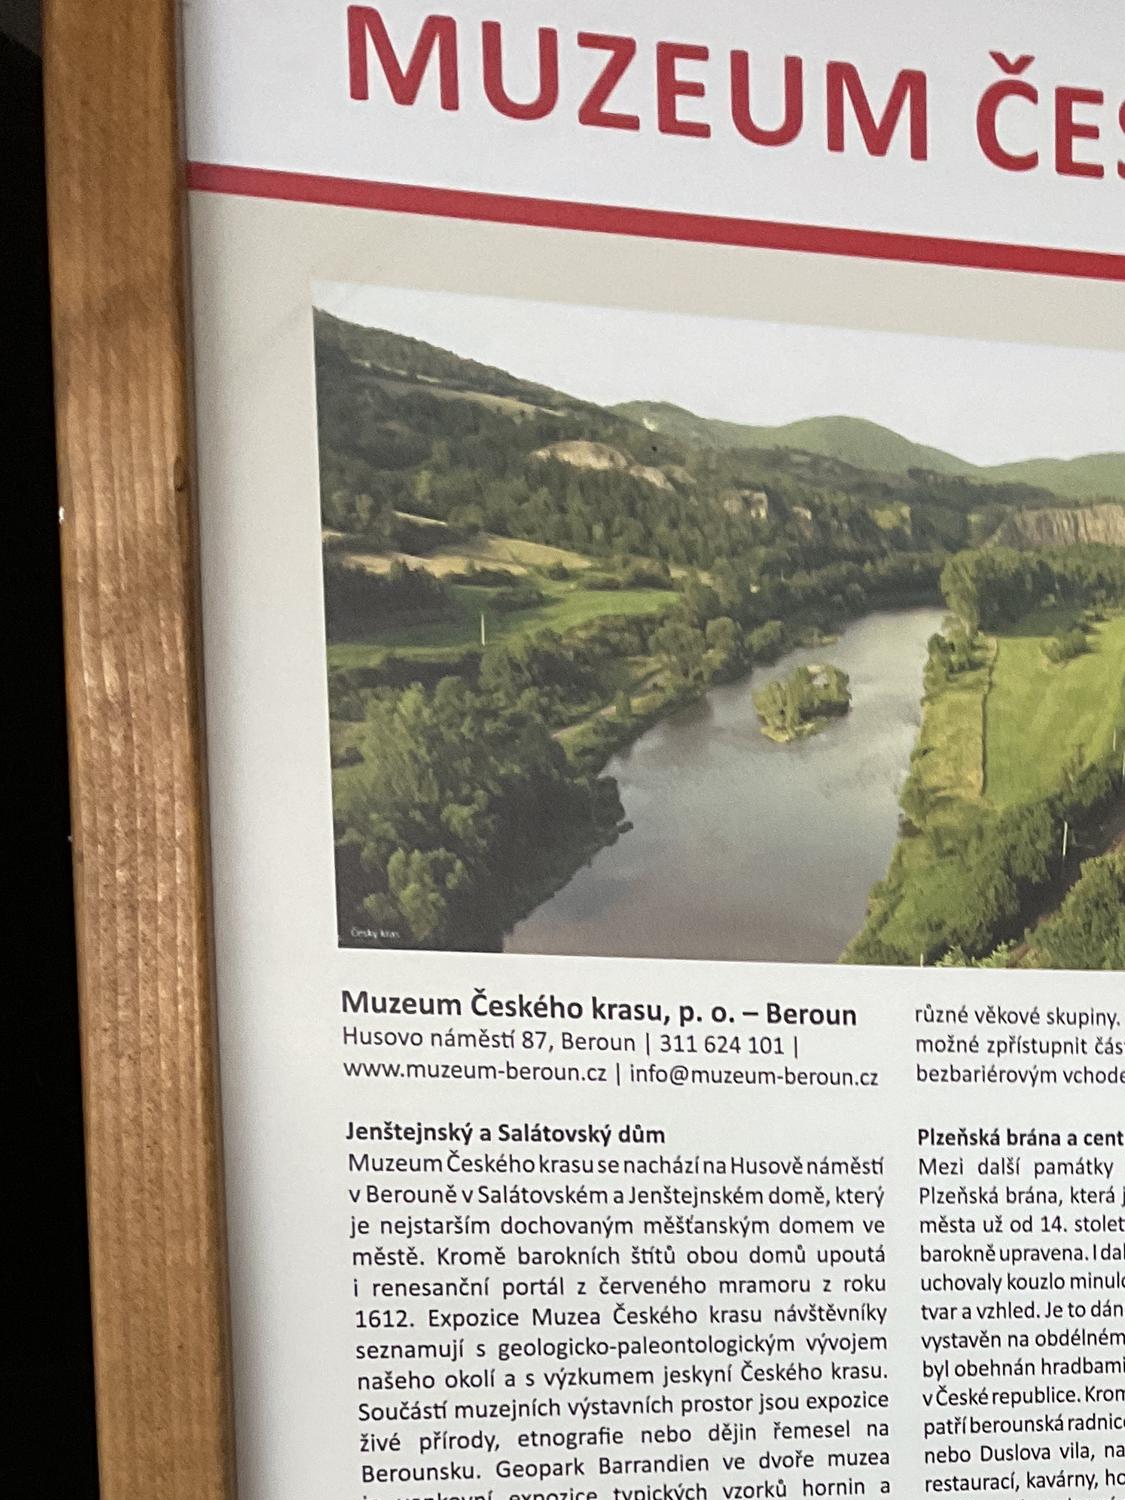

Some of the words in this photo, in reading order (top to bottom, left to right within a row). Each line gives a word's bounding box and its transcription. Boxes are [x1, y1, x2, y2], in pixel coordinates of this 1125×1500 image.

[347, 5, 929, 162] MUZEUM
[341, 990, 462, 1016] Muzeum
[471, 990, 583, 1020] Českého
[591, 996, 670, 1026] krasu,
[679, 1005, 703, 1028] p.
[711, 1006, 735, 1024] o.
[766, 1002, 857, 1026] Beroun
[915, 1003, 969, 1025] různé
[974, 1005, 1040, 1025] věkové
[1046, 1006, 1121, 1031] skupiny.
[343, 1025, 423, 1047] Husovo
[430, 1027, 516, 1049] náměstí
[522, 1030, 554, 1053] 87,
[561, 1031, 636, 1052] Beroun
[660, 1033, 698, 1053] 311
[704, 1035, 742, 1054] 624
[748, 1036, 785, 1055] 101
[916, 1034, 979, 1054] možné
[987, 1034, 1088, 1059] zpřístupnit
[343, 1060, 607, 1082] www.muzeum-beroun.cz
[630, 1063, 879, 1087] info@muzeum-beroun.cz
[916, 1063, 1057, 1088] bezbariérovým
[345, 1120, 474, 1146] Jenštejnský
[479, 1127, 492, 1142] a
[498, 1122, 612, 1148] Salátovský
[618, 1123, 666, 1144] dům
[918, 1127, 1000, 1147] Plzeňská
[1006, 1127, 1061, 1147] brána
[1067, 1132, 1078, 1147] a
[918, 1156, 964, 1176] Mezi
[977, 1156, 1021, 1176] další
[1034, 1156, 1114, 1180] památky
[349, 1215, 370, 1239] je
[380, 1214, 490, 1239] nejstarším
[500, 1215, 634, 1239] dochovaným
[643, 1214, 770, 1239] měšťanským
[779, 1215, 854, 1234] domem
[862, 1219, 885, 1234] ve
[919, 1214, 976, 1234] města
[983, 1214, 1003, 1234] už
[1009, 1214, 1033, 1233] od
[1040, 1215, 1068, 1233] 14.
[355, 1309, 415, 1329] 1612.
[428, 1307, 519, 1332] Expozice
[532, 1307, 601, 1326] Muzea
[613, 1303, 698, 1325] Českého
[709, 1304, 762, 1324] krasu
[774, 1302, 888, 1326] návštěvníky
[360, 1432, 401, 1453] živé
[419, 1429, 500, 1455] přírody,
[518, 1426, 624, 1450] etnografie
[641, 1424, 692, 1444] nebo
[708, 1422, 757, 1446] dějin
[773, 1419, 850, 1440] řemesel
[866, 1423, 889, 1437] na
